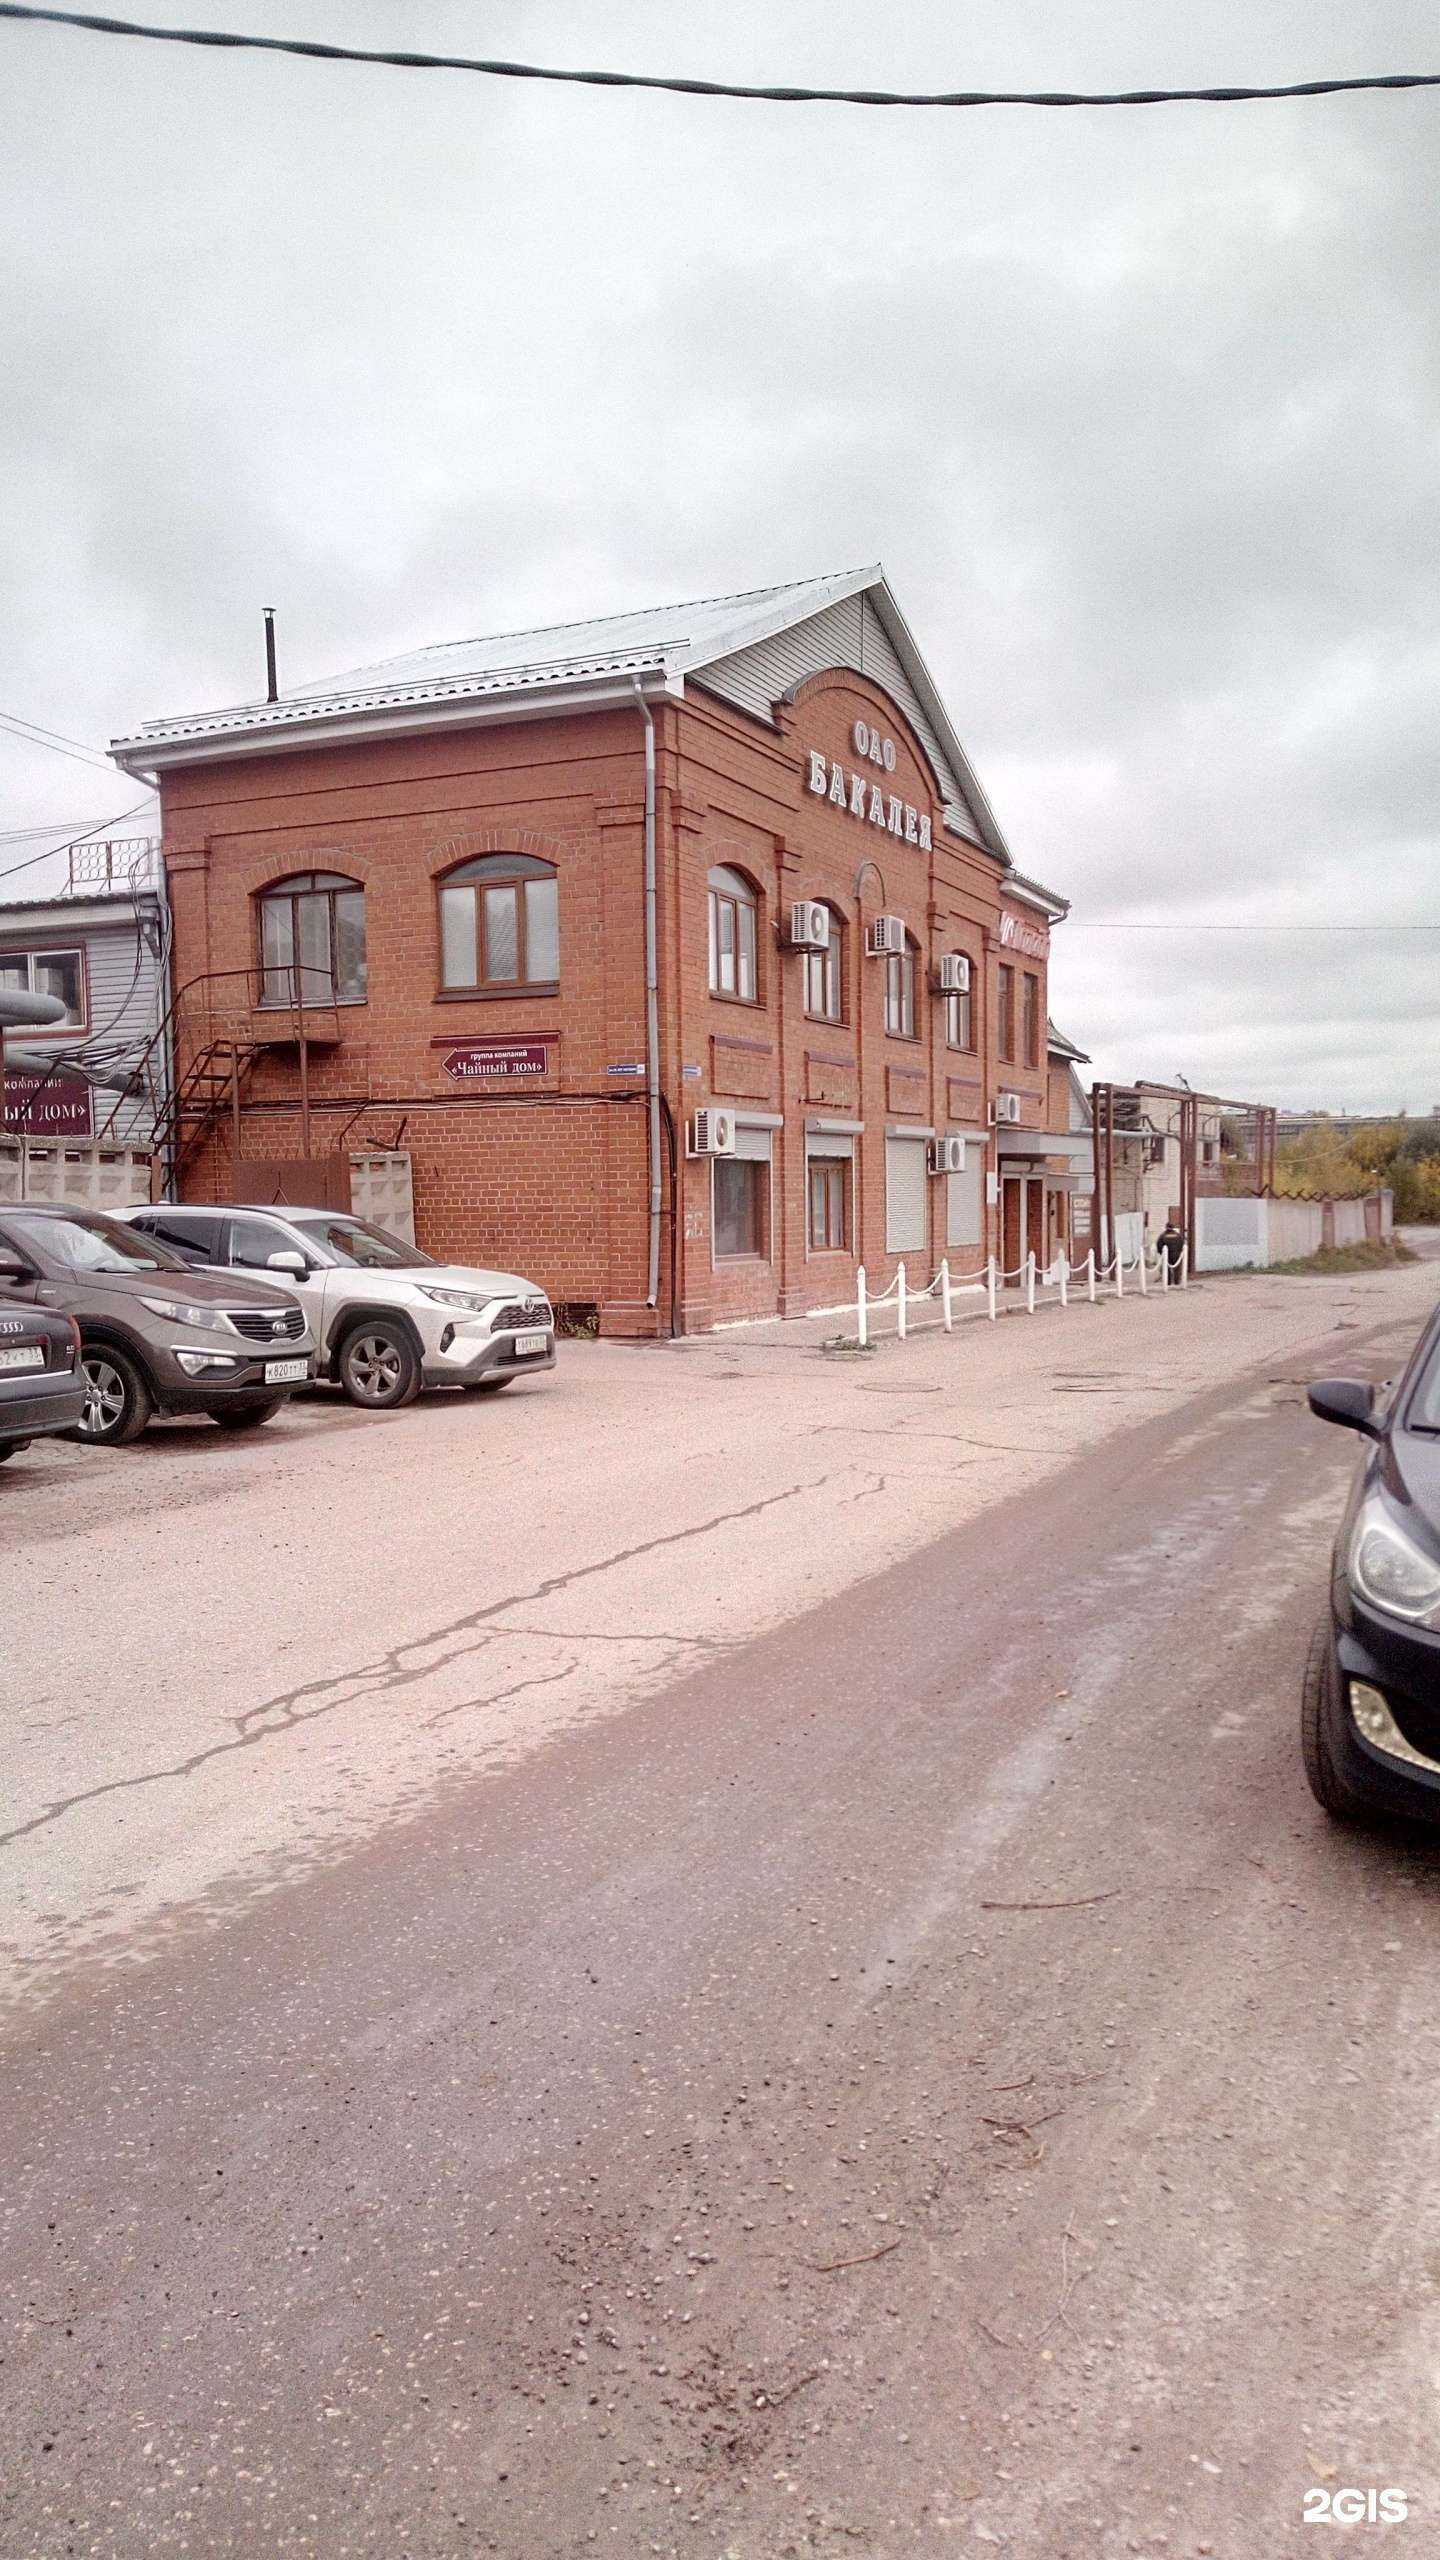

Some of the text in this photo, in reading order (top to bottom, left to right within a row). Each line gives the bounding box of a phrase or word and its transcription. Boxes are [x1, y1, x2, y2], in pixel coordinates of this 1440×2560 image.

[854, 720, 897, 772] ОАО
[808, 749, 933, 852] БАКАЛЕЯ
[471, 1050, 528, 1061] группа компаний
[451, 1061, 543, 1075] «Чайный дом»
[39, 1104, 86, 1121] дом»
